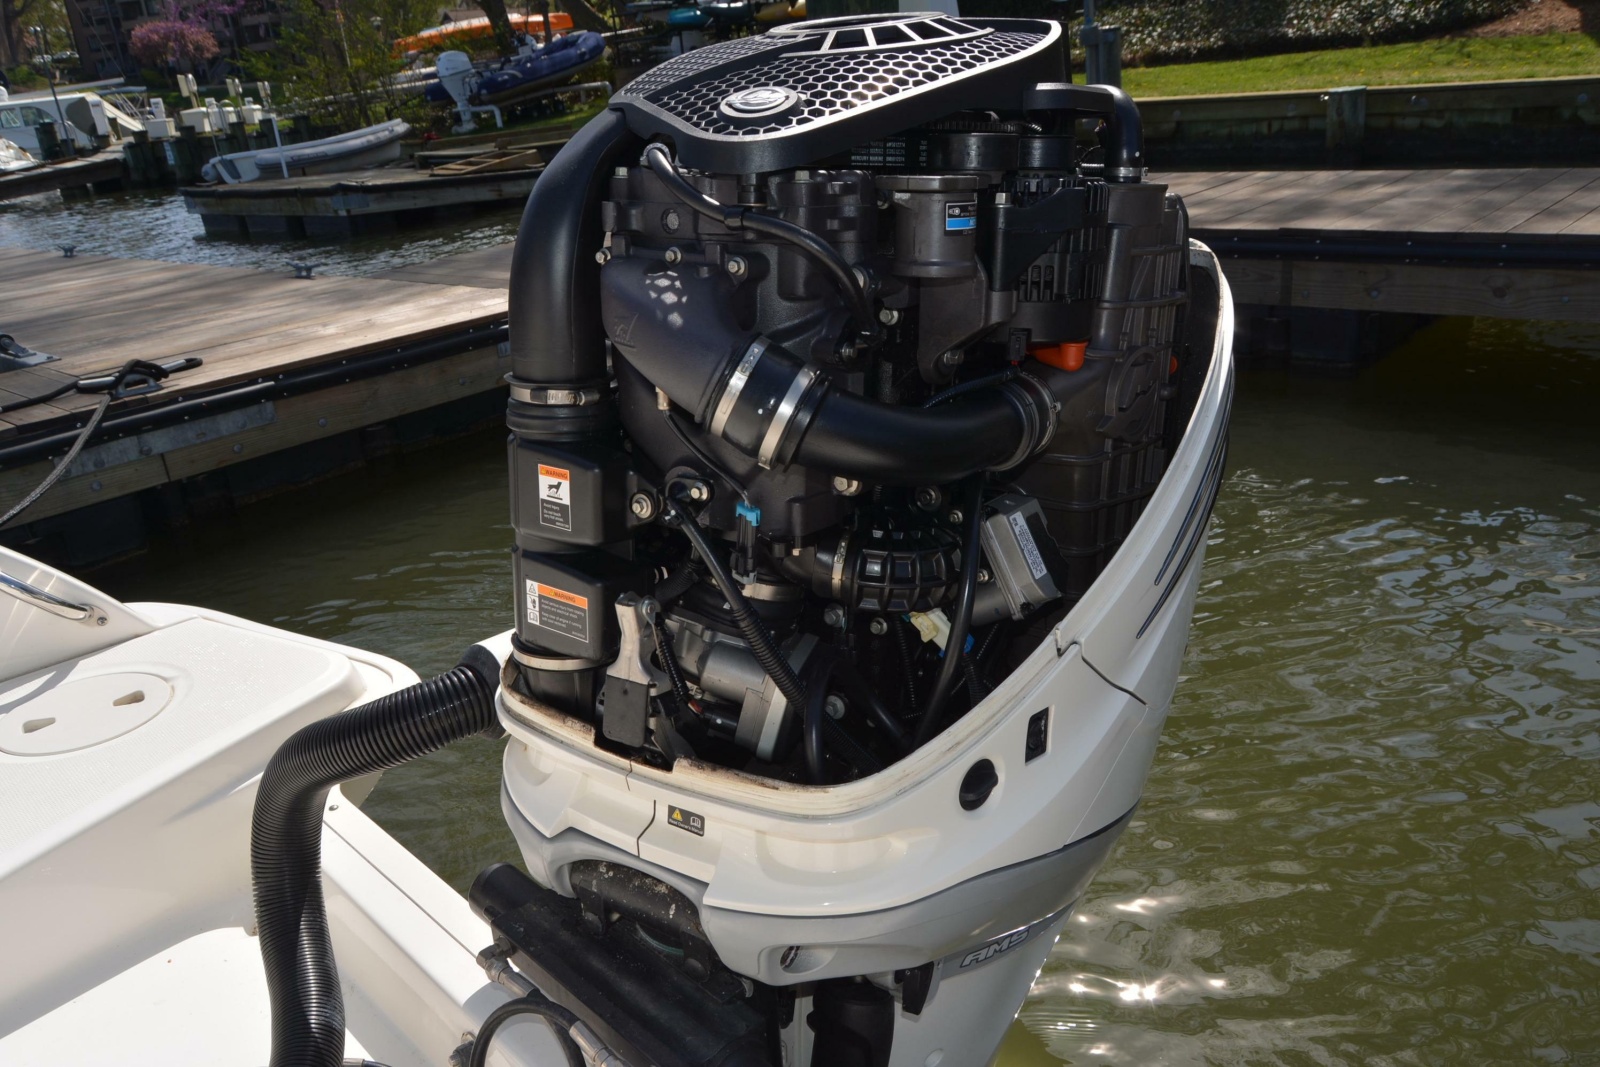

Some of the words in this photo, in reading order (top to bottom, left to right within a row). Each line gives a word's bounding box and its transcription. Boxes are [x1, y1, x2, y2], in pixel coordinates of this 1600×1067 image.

[545, 470, 568, 479] WARNING
[555, 592, 576, 602] WARNING
[960, 926, 1031, 968] AMS
